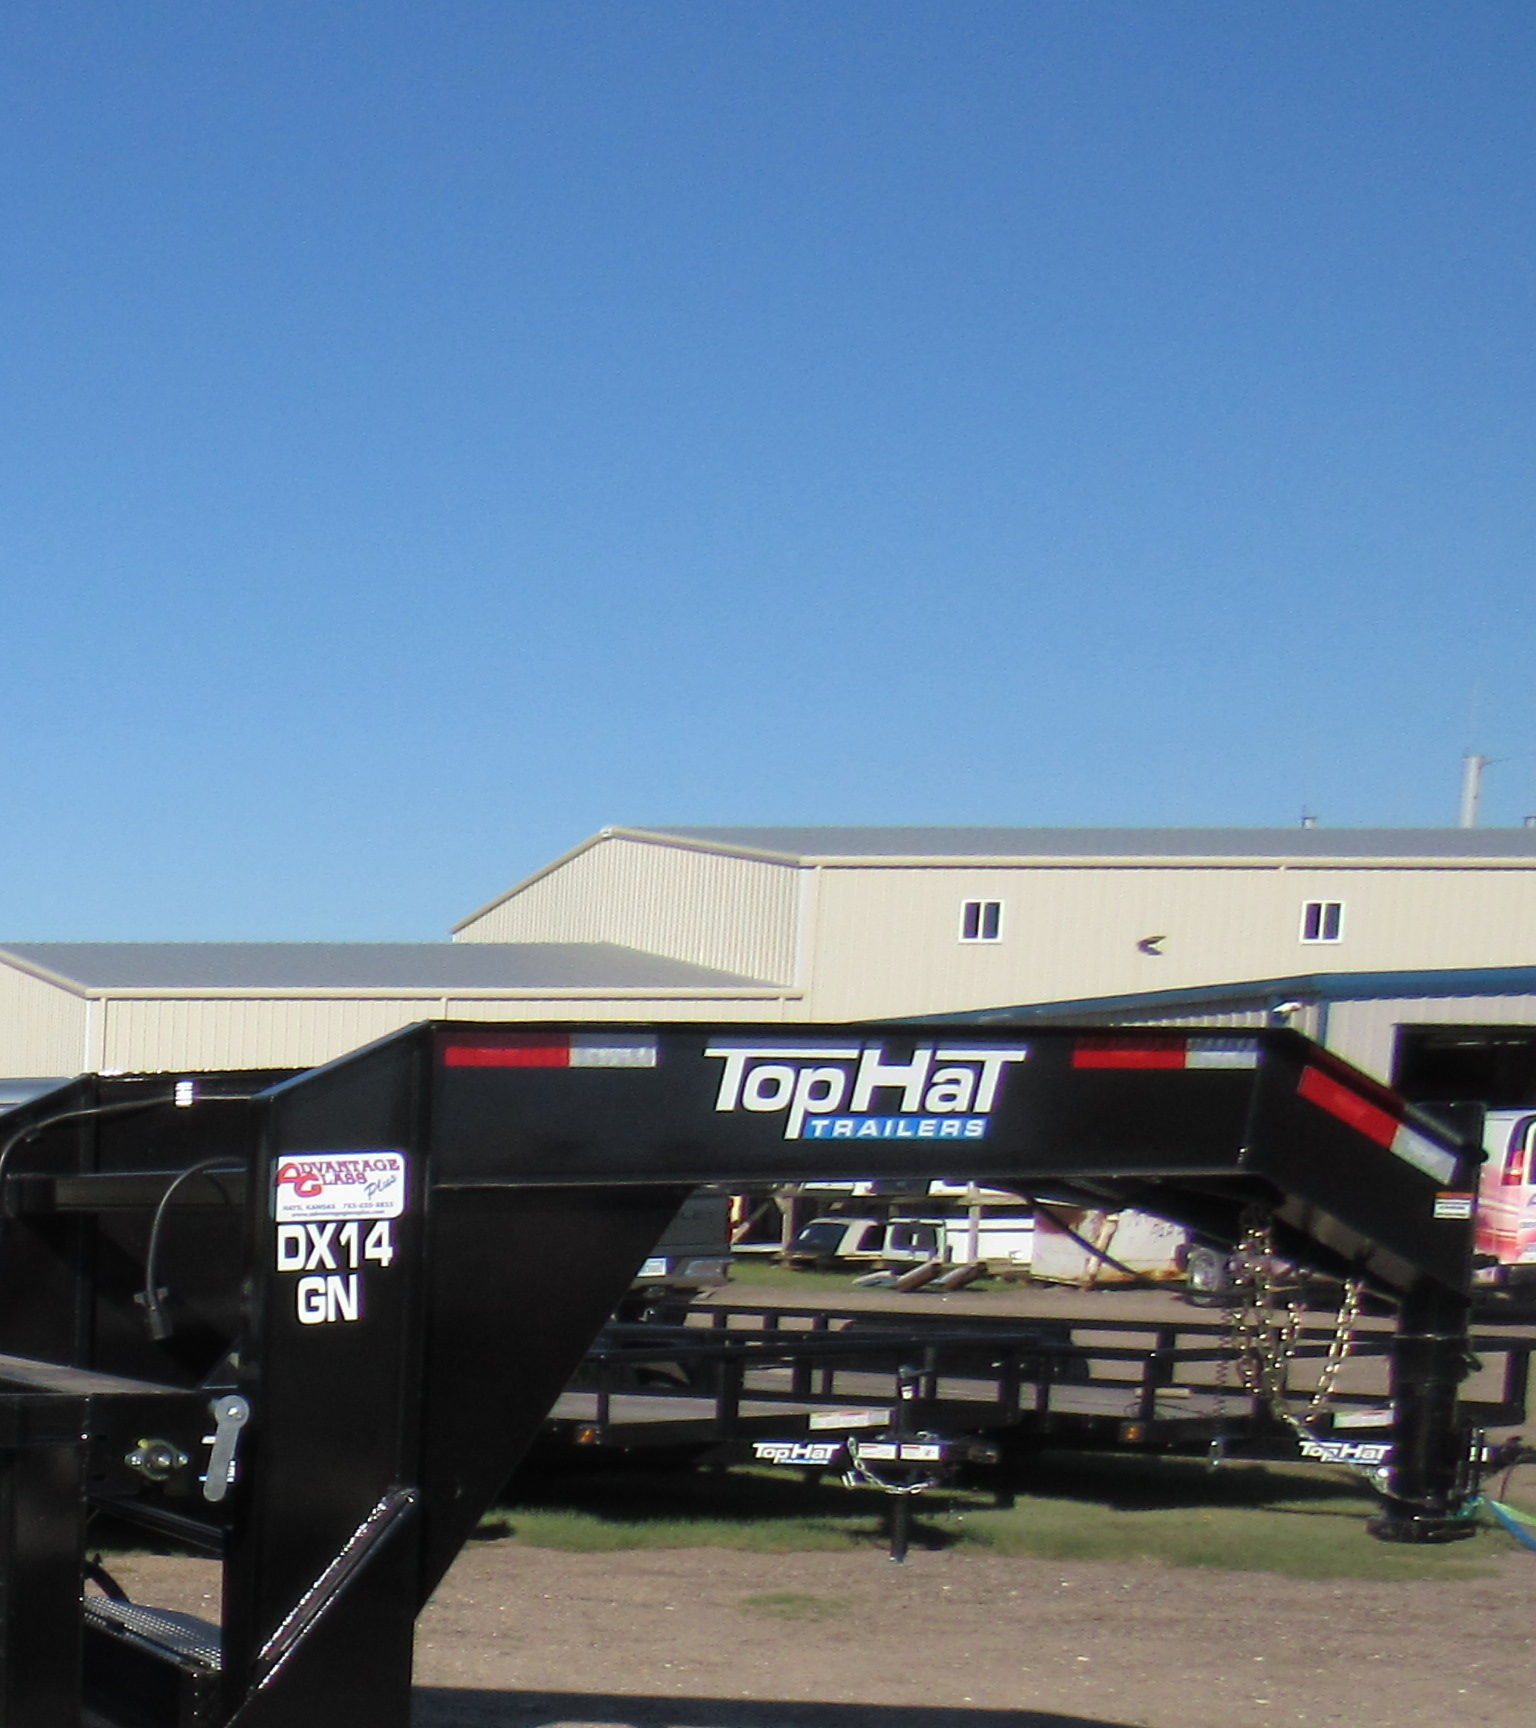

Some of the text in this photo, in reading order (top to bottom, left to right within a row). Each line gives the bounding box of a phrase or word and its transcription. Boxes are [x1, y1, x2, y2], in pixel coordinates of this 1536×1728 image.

[810, 1119, 987, 1138] TRAILERS
[275, 1159, 401, 1186] ADVANTAGE
[276, 1220, 394, 1272] DX14
[297, 1273, 359, 1325] GN
